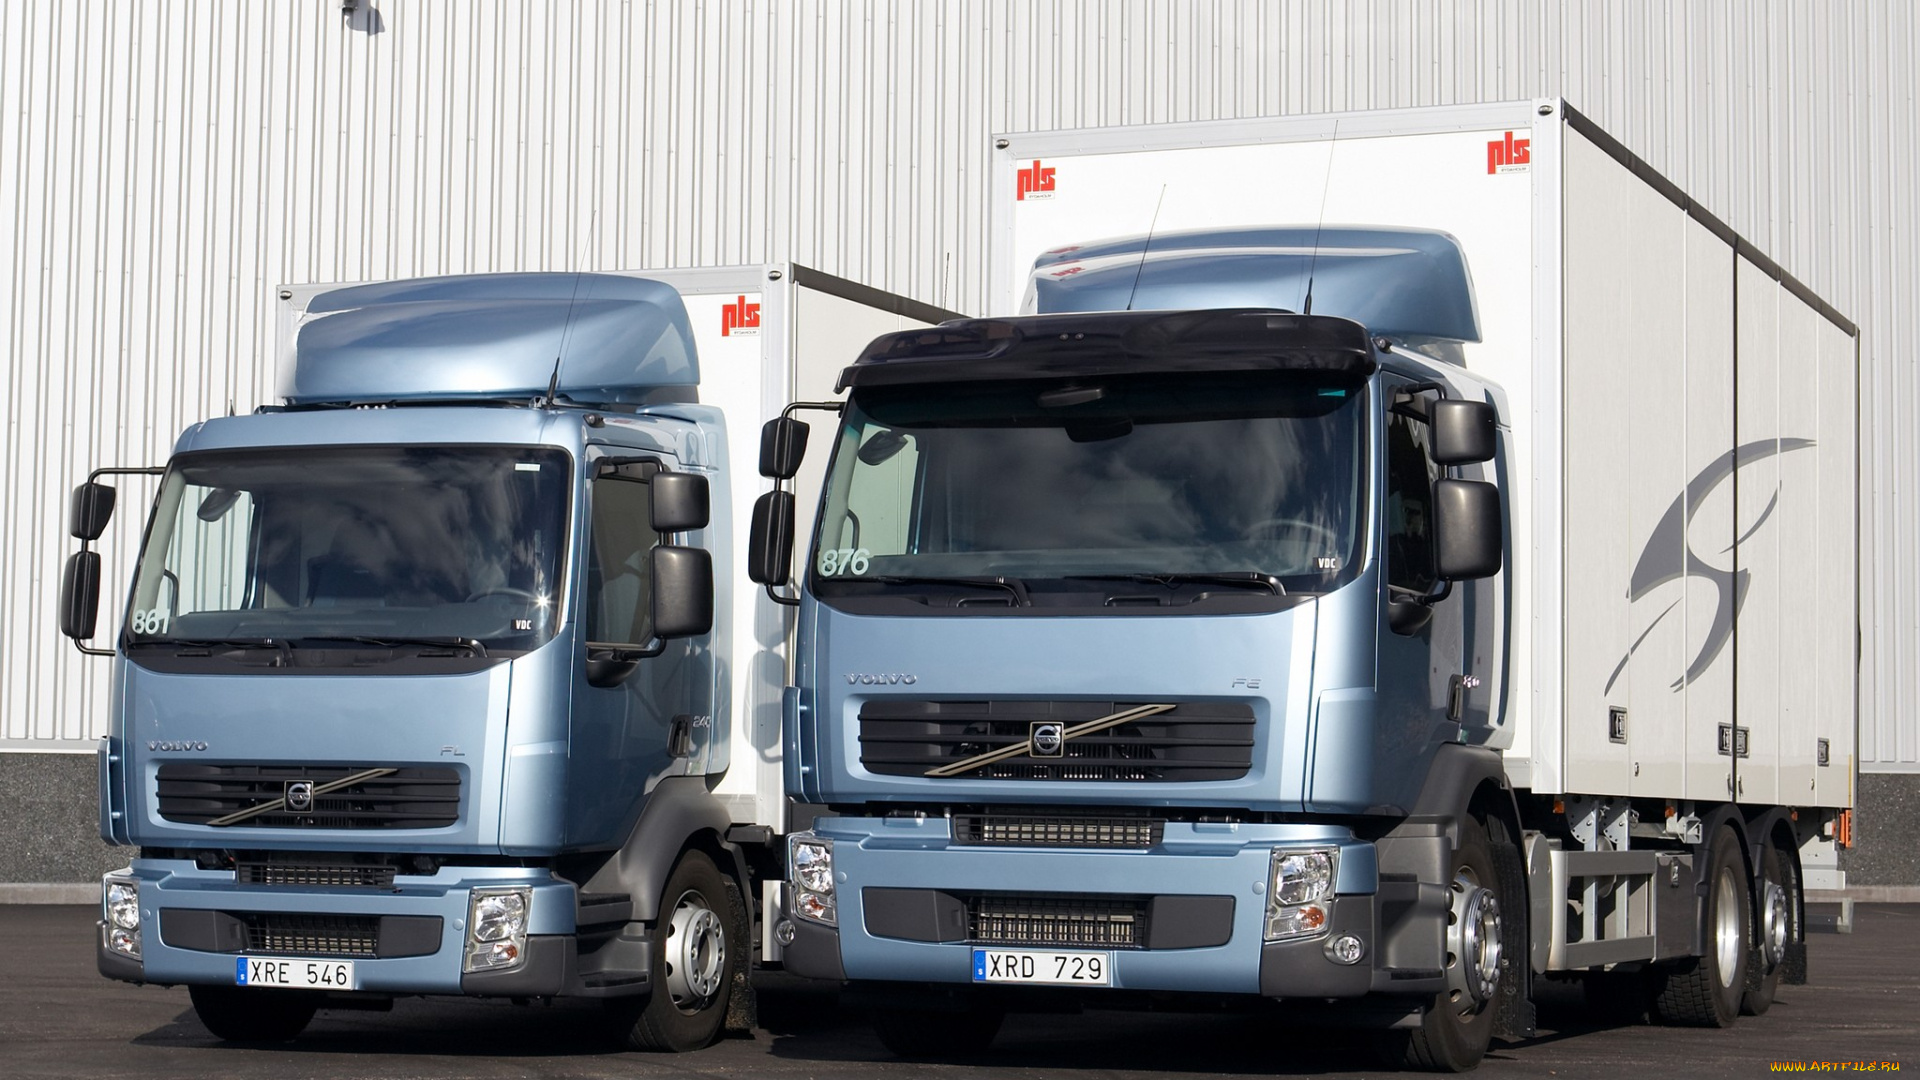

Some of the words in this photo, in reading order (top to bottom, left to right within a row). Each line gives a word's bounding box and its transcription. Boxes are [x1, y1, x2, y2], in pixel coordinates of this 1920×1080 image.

[1487, 131, 1530, 175] pls
[1016, 160, 1056, 201] pls
[721, 295, 761, 337] pls
[821, 549, 870, 577] 876
[1318, 557, 1336, 569] VDC
[132, 609, 171, 635] 861
[515, 619, 532, 630] VDC
[845, 672, 917, 685] VOLVO
[1232, 678, 1262, 689] FE
[692, 715, 712, 728] 240
[147, 740, 209, 752] VOLVO
[440, 745, 466, 756] FL
[240, 973, 246, 981] S
[251, 961, 290, 984] XRE
[307, 963, 348, 986] 546
[977, 968, 984, 976] S
[989, 954, 1034, 978] XRD
[1054, 956, 1102, 980] 729
